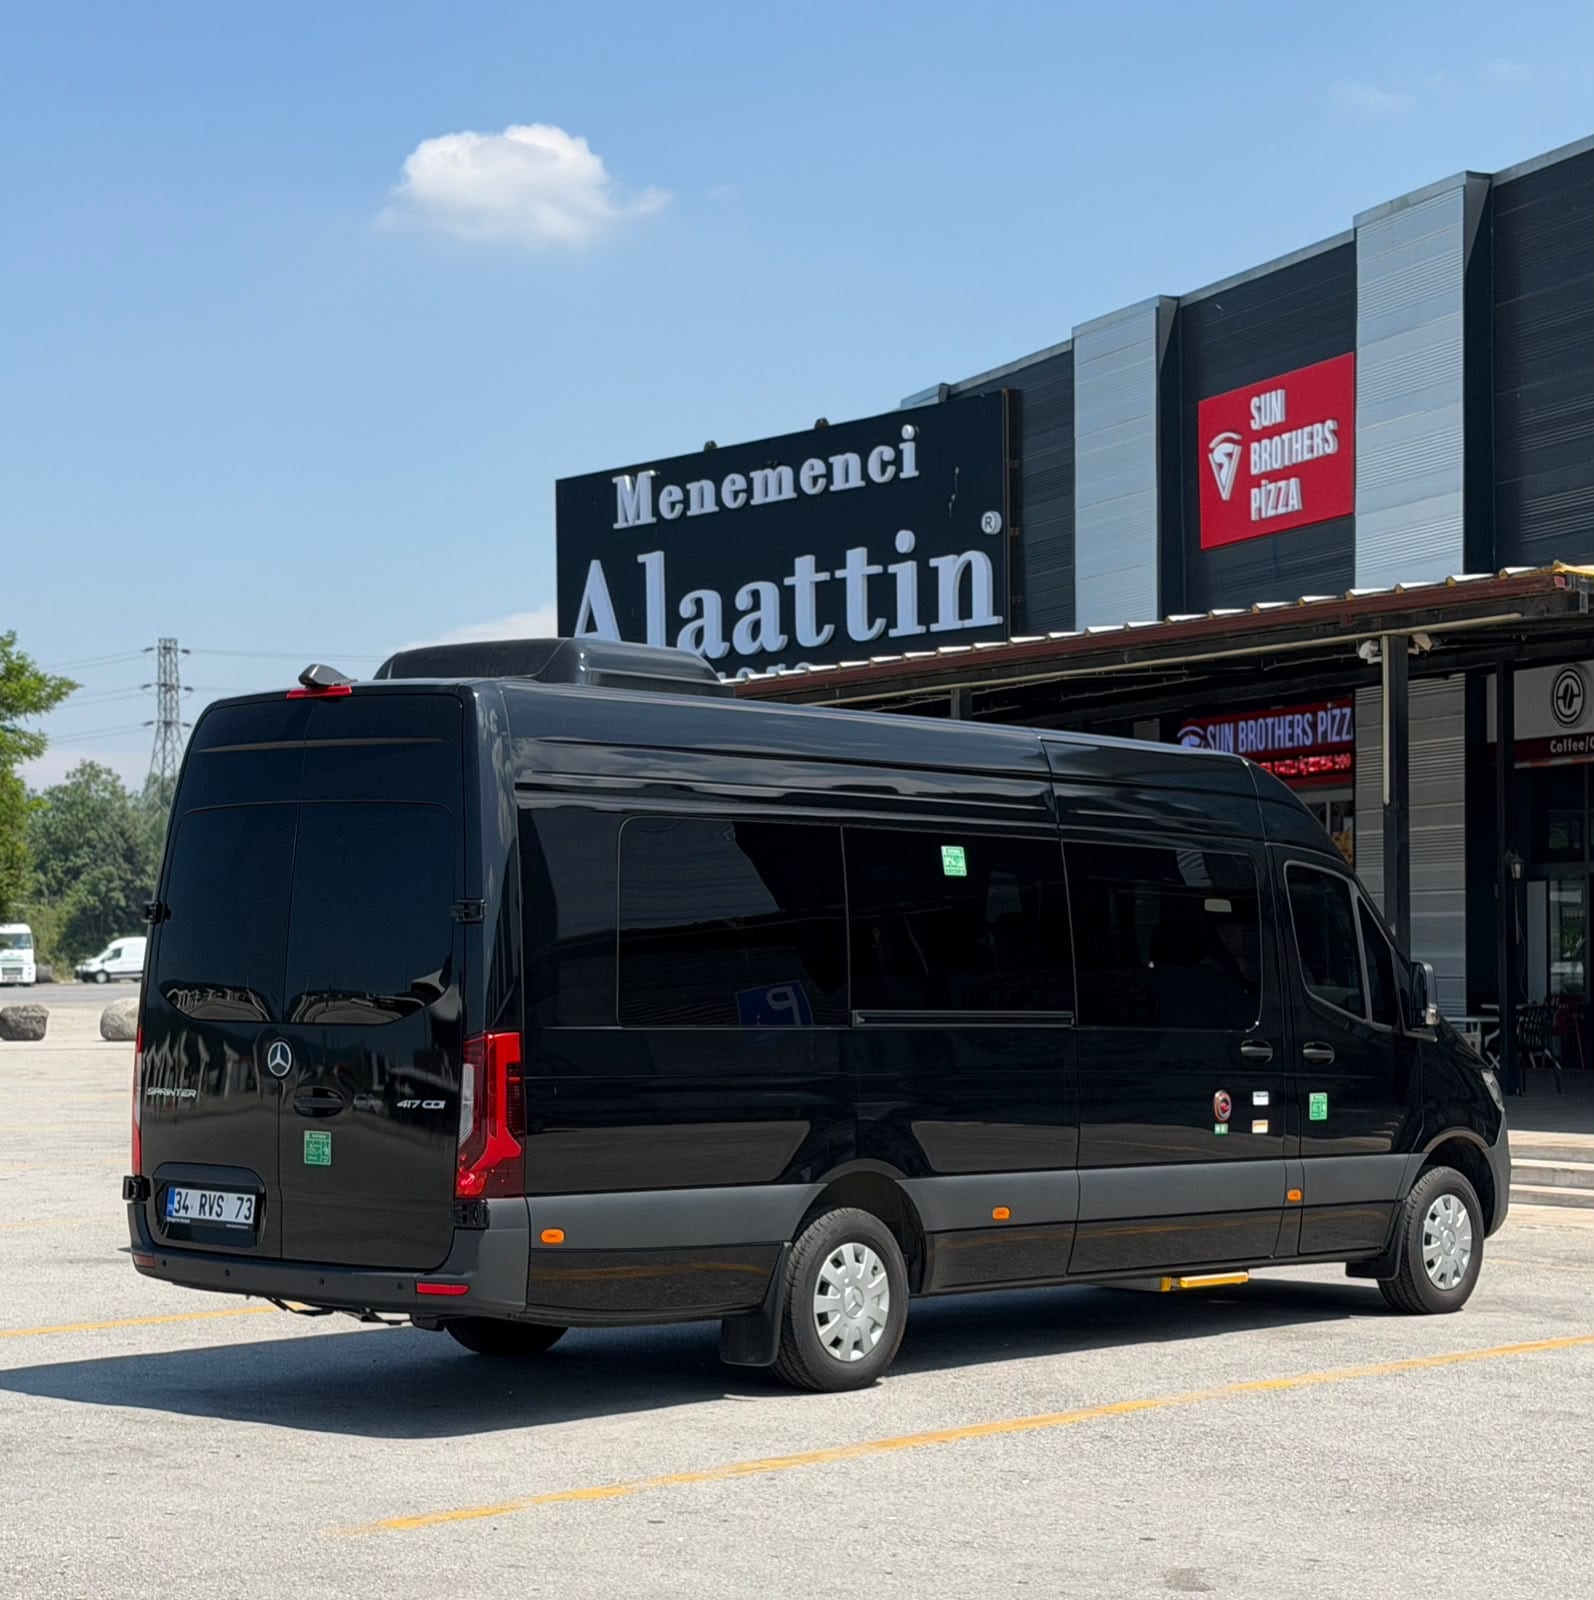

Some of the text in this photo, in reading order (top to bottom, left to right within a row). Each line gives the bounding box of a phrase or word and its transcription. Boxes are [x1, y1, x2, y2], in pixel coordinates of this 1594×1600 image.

[1250, 389, 1285, 430] SUN
[1250, 419, 1338, 475] BROTHERS
[612, 424, 920, 529] Menemenci
[1250, 477, 1303, 521] PİZZA
[573, 529, 1003, 659] Alaattin
[1207, 702, 1353, 753] SUN BROTHERS PİZZ
[146, 1087, 197, 1098] SPRINTER
[396, 1099, 446, 1110] 417 CDI
[174, 1191, 253, 1221] 34 RVS 73
